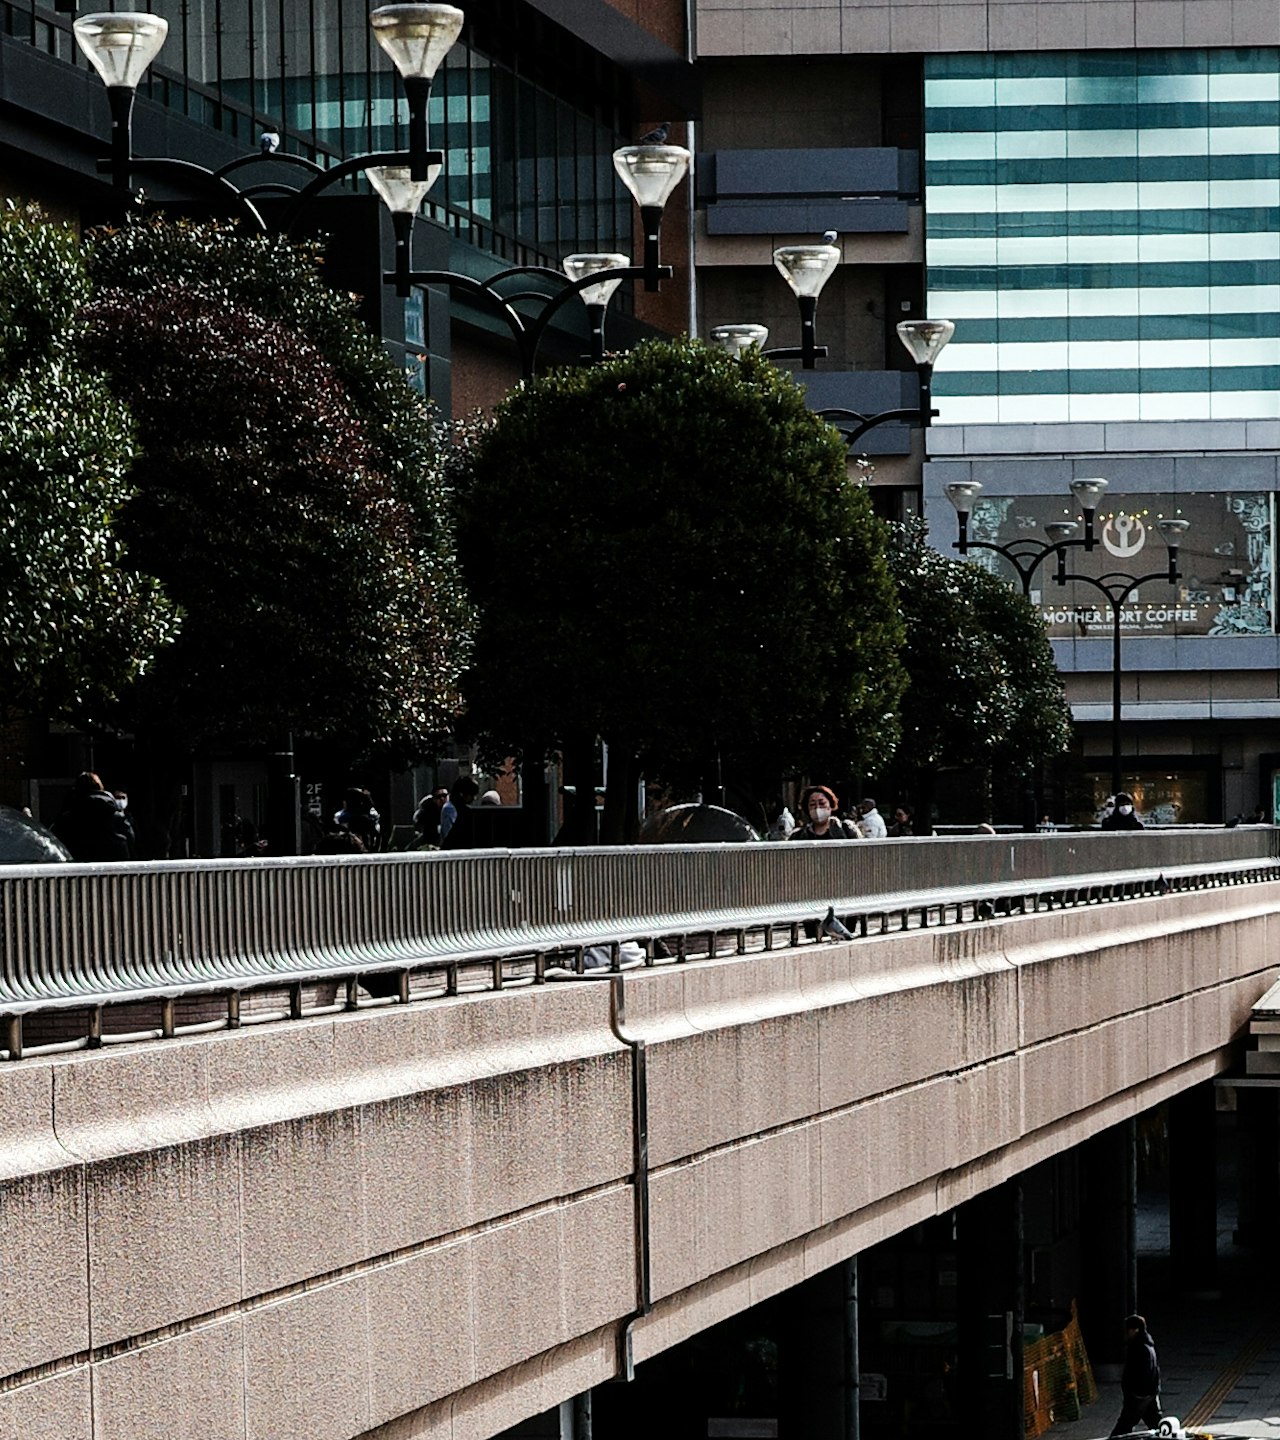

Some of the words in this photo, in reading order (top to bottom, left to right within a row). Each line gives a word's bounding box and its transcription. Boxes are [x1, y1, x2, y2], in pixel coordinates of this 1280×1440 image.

[1043, 609, 1104, 624] MOTHER
[1106, 609, 1144, 623] PORT
[1145, 608, 1198, 622] COFFEE
